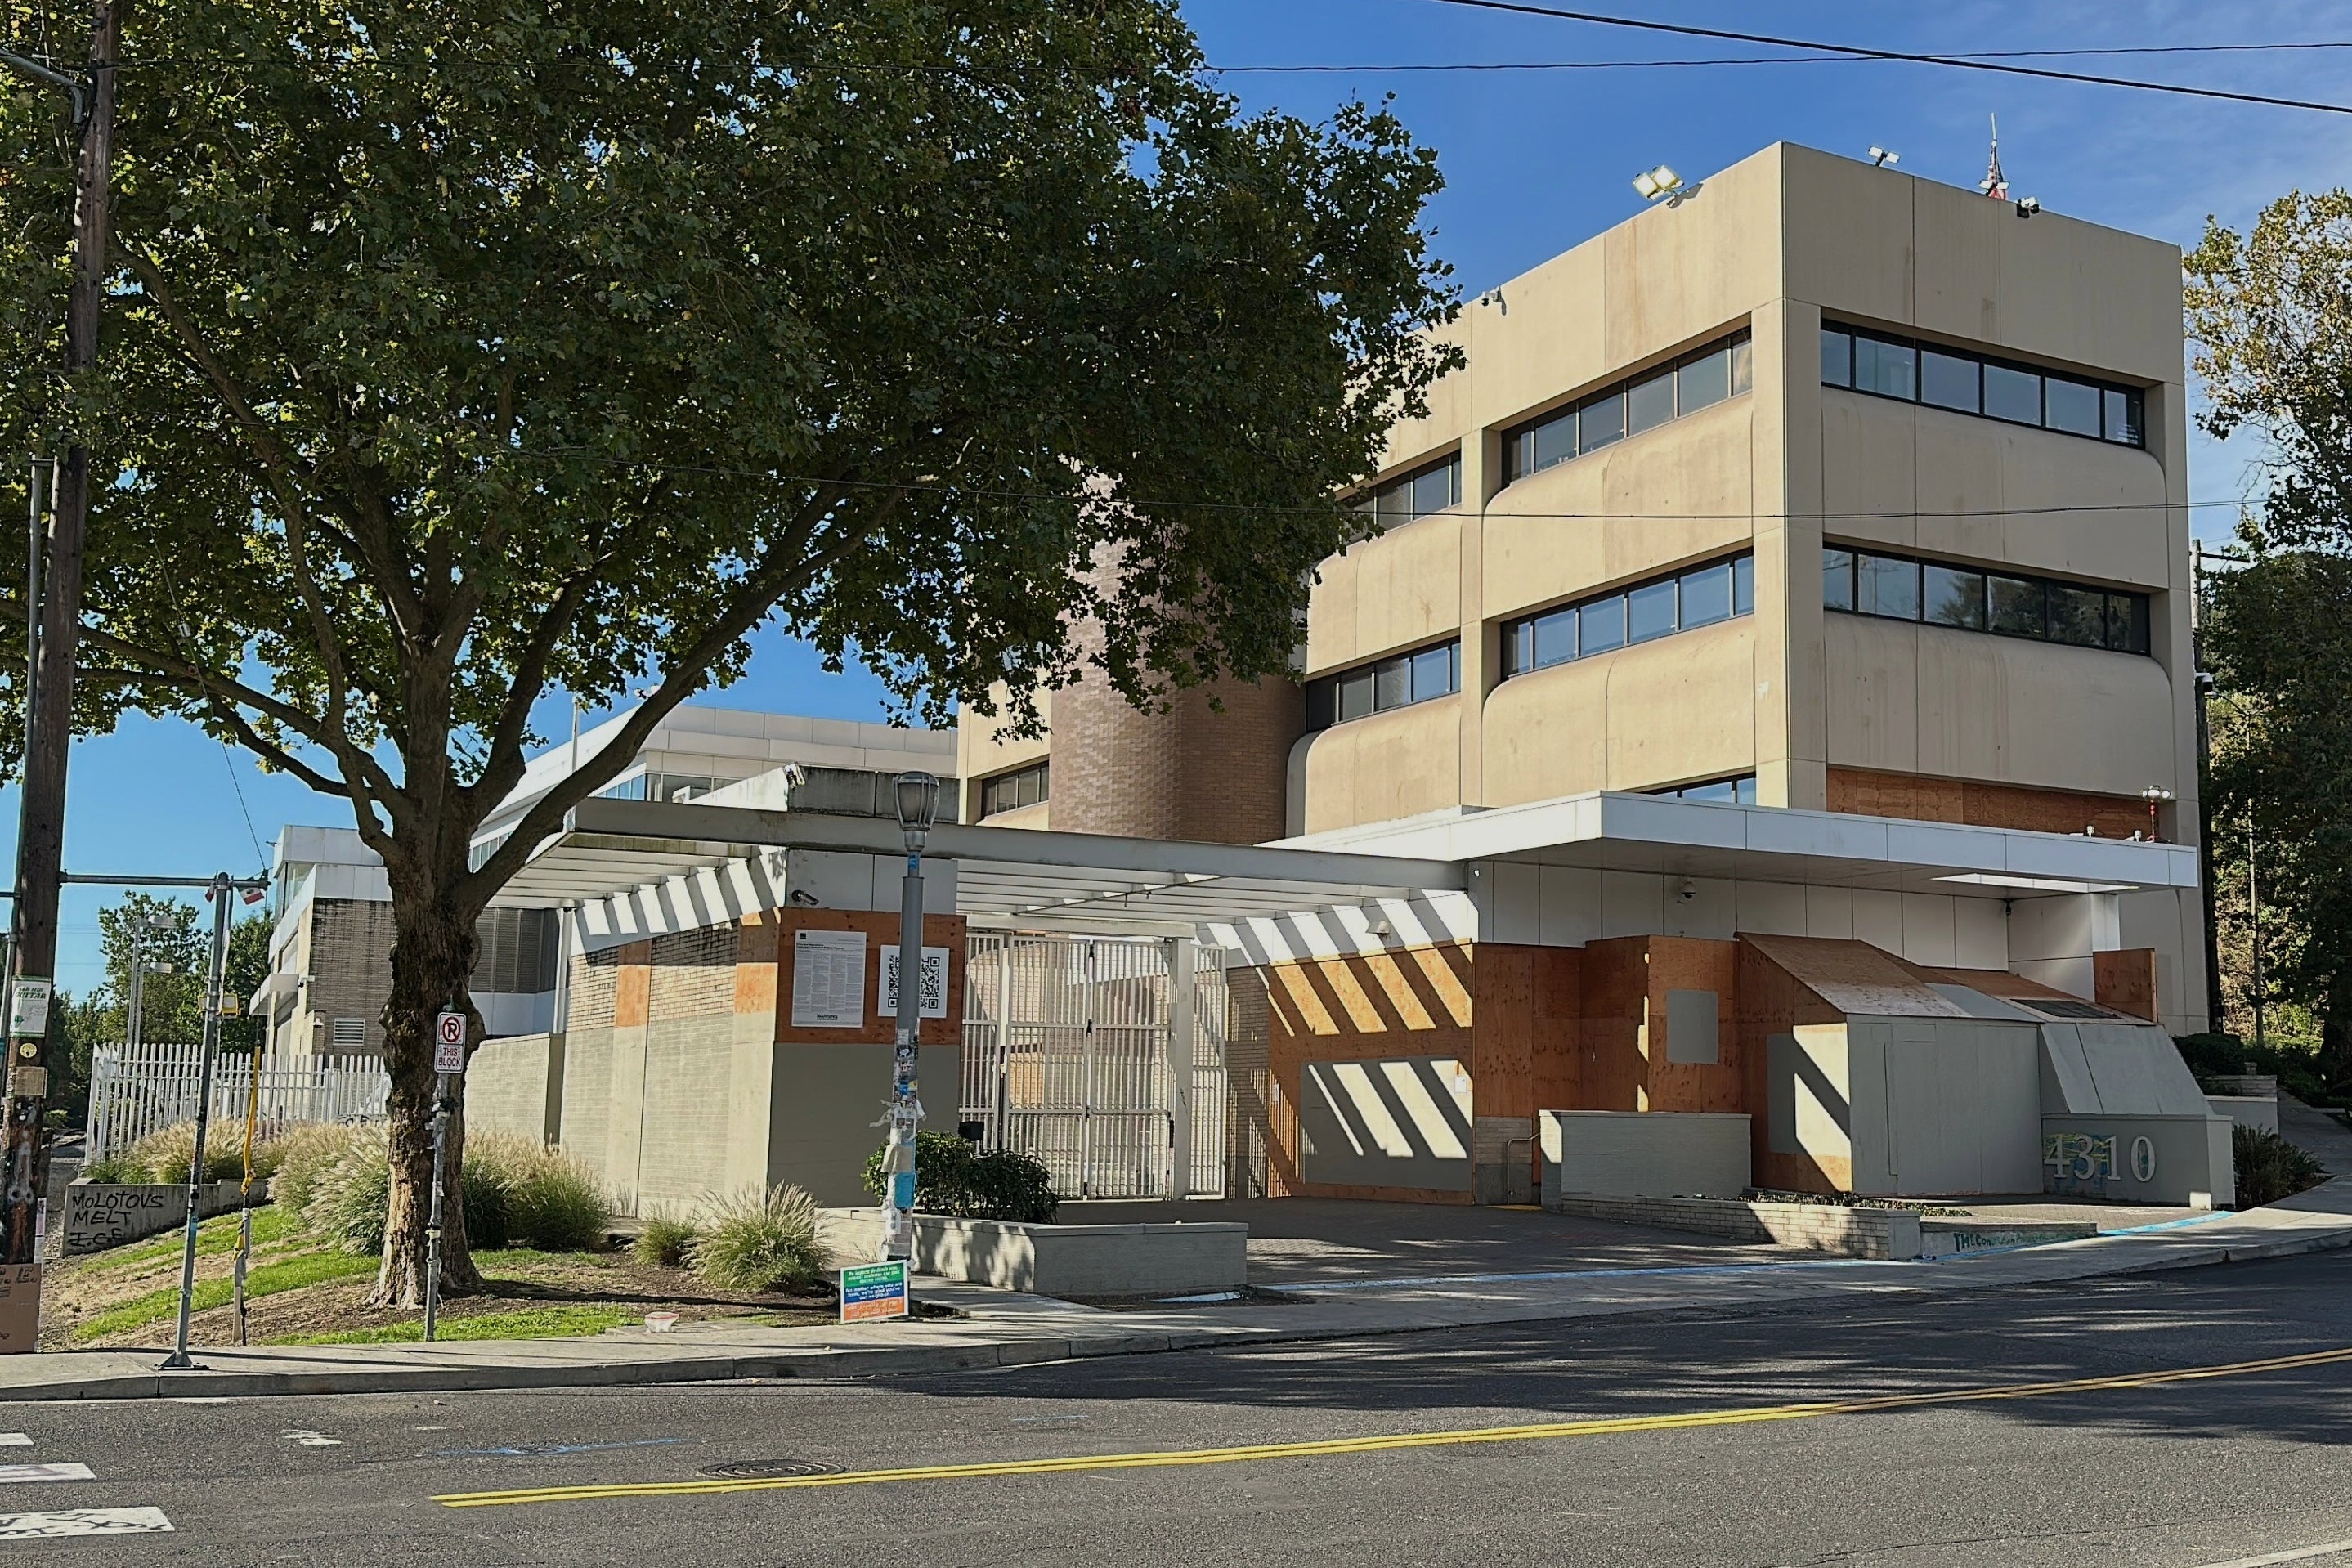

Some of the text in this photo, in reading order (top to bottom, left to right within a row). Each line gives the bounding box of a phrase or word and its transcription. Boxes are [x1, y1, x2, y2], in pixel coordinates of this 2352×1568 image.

[444, 1048, 458, 1056] THIS
[439, 1057, 460, 1066] BLOCK
[2044, 1133, 2156, 1182] 4310
[72, 1210, 132, 1226] MELT
[1953, 1232, 1975, 1252] THE
